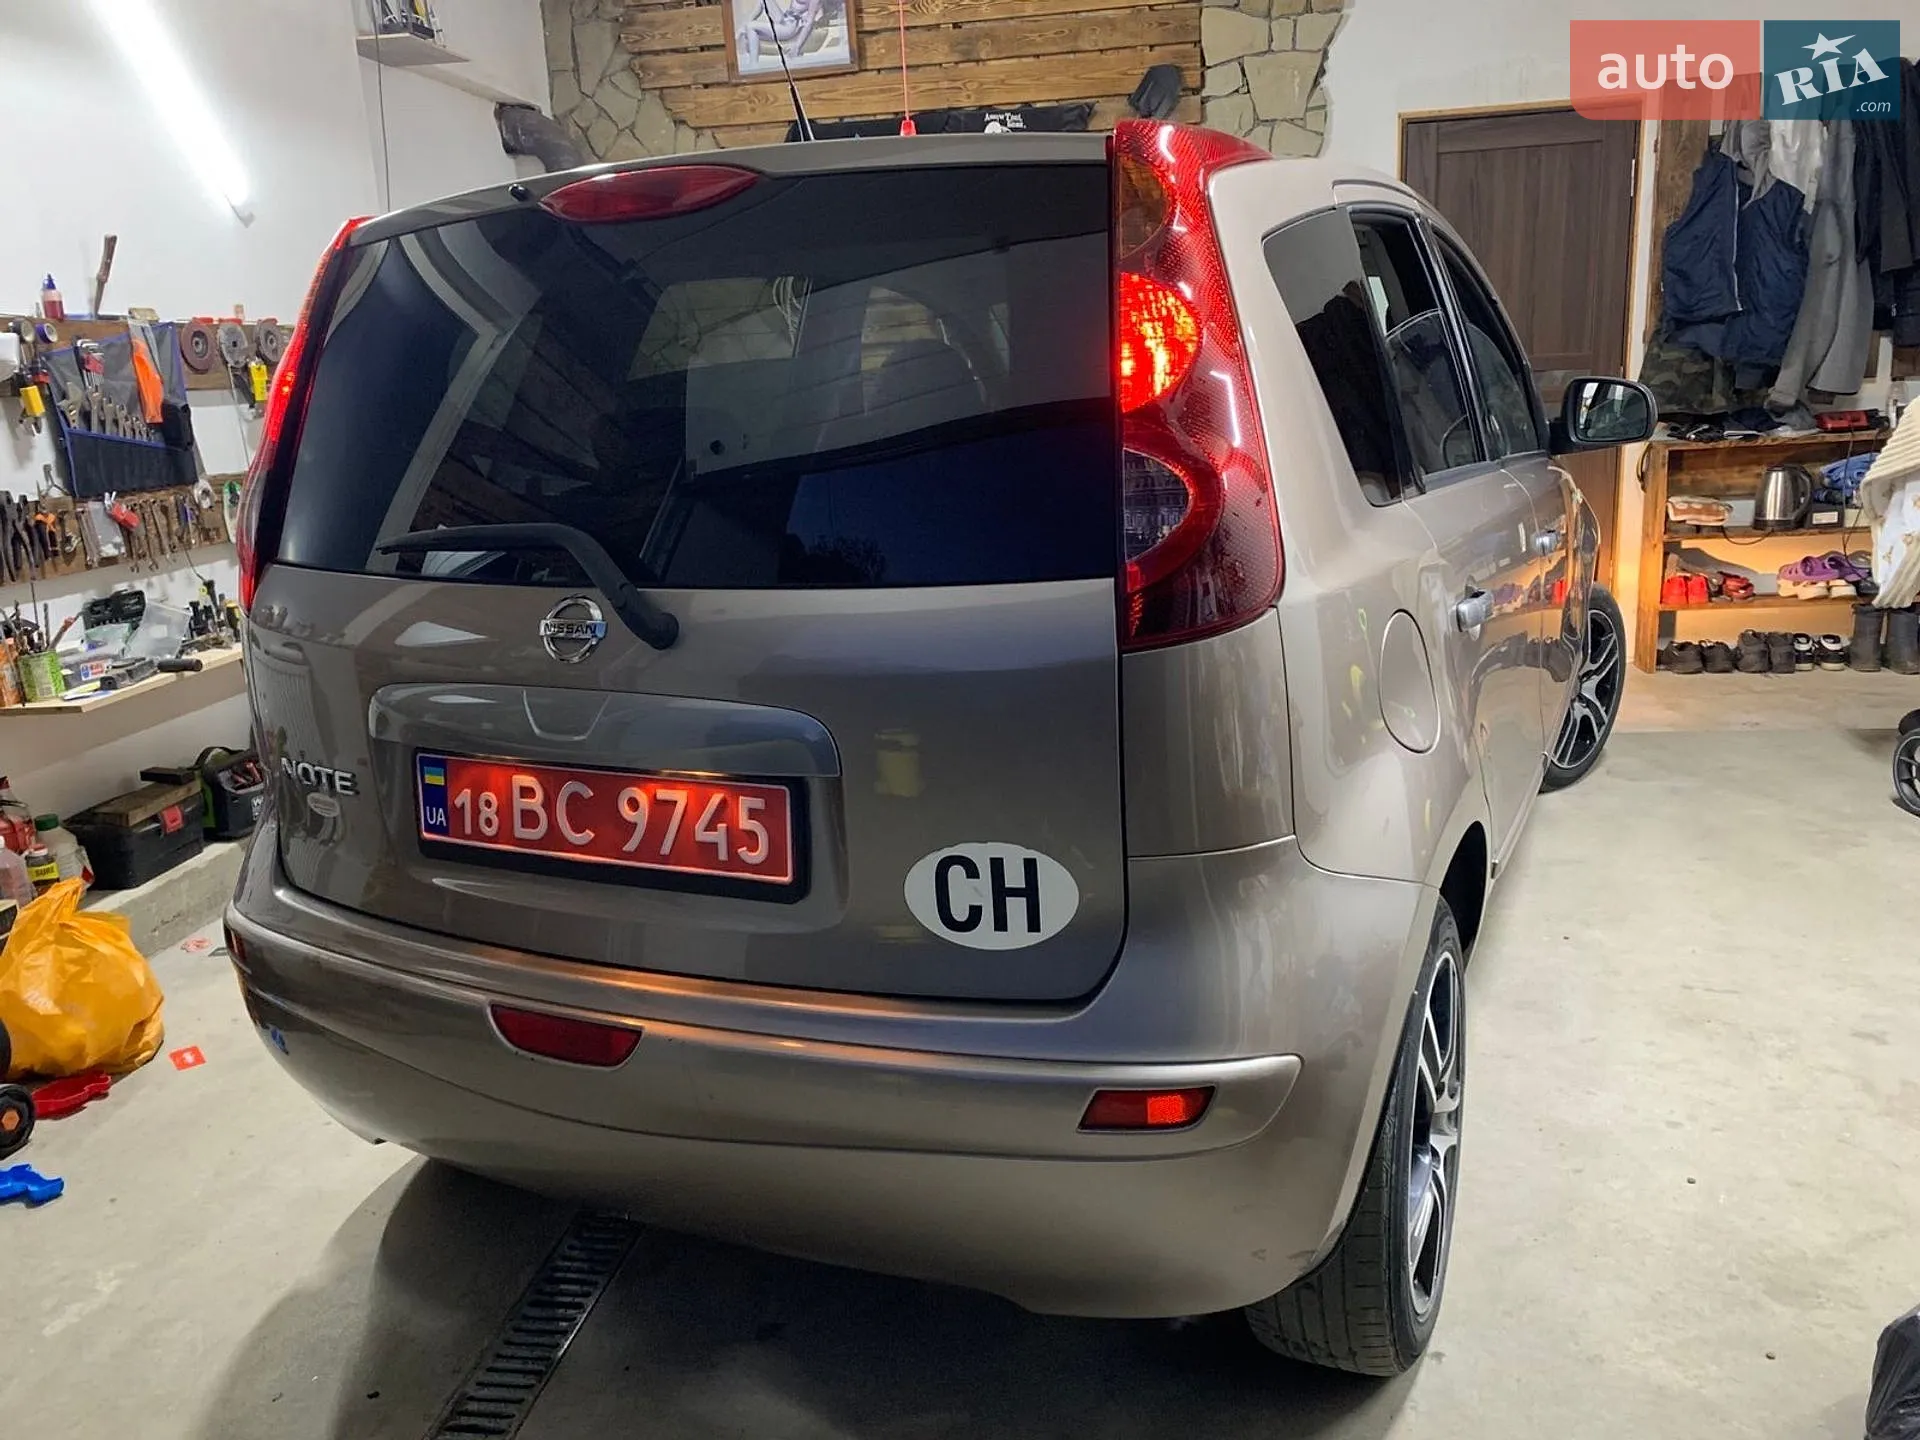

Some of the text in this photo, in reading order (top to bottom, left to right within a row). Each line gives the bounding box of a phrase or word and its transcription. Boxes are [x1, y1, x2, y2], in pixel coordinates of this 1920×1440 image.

[543, 622, 597, 636] NISSAN
[281, 757, 356, 796] NOTE
[425, 805, 447, 827] UA
[453, 775, 770, 866] 18 BC 9745
[934, 854, 1042, 934] CH
